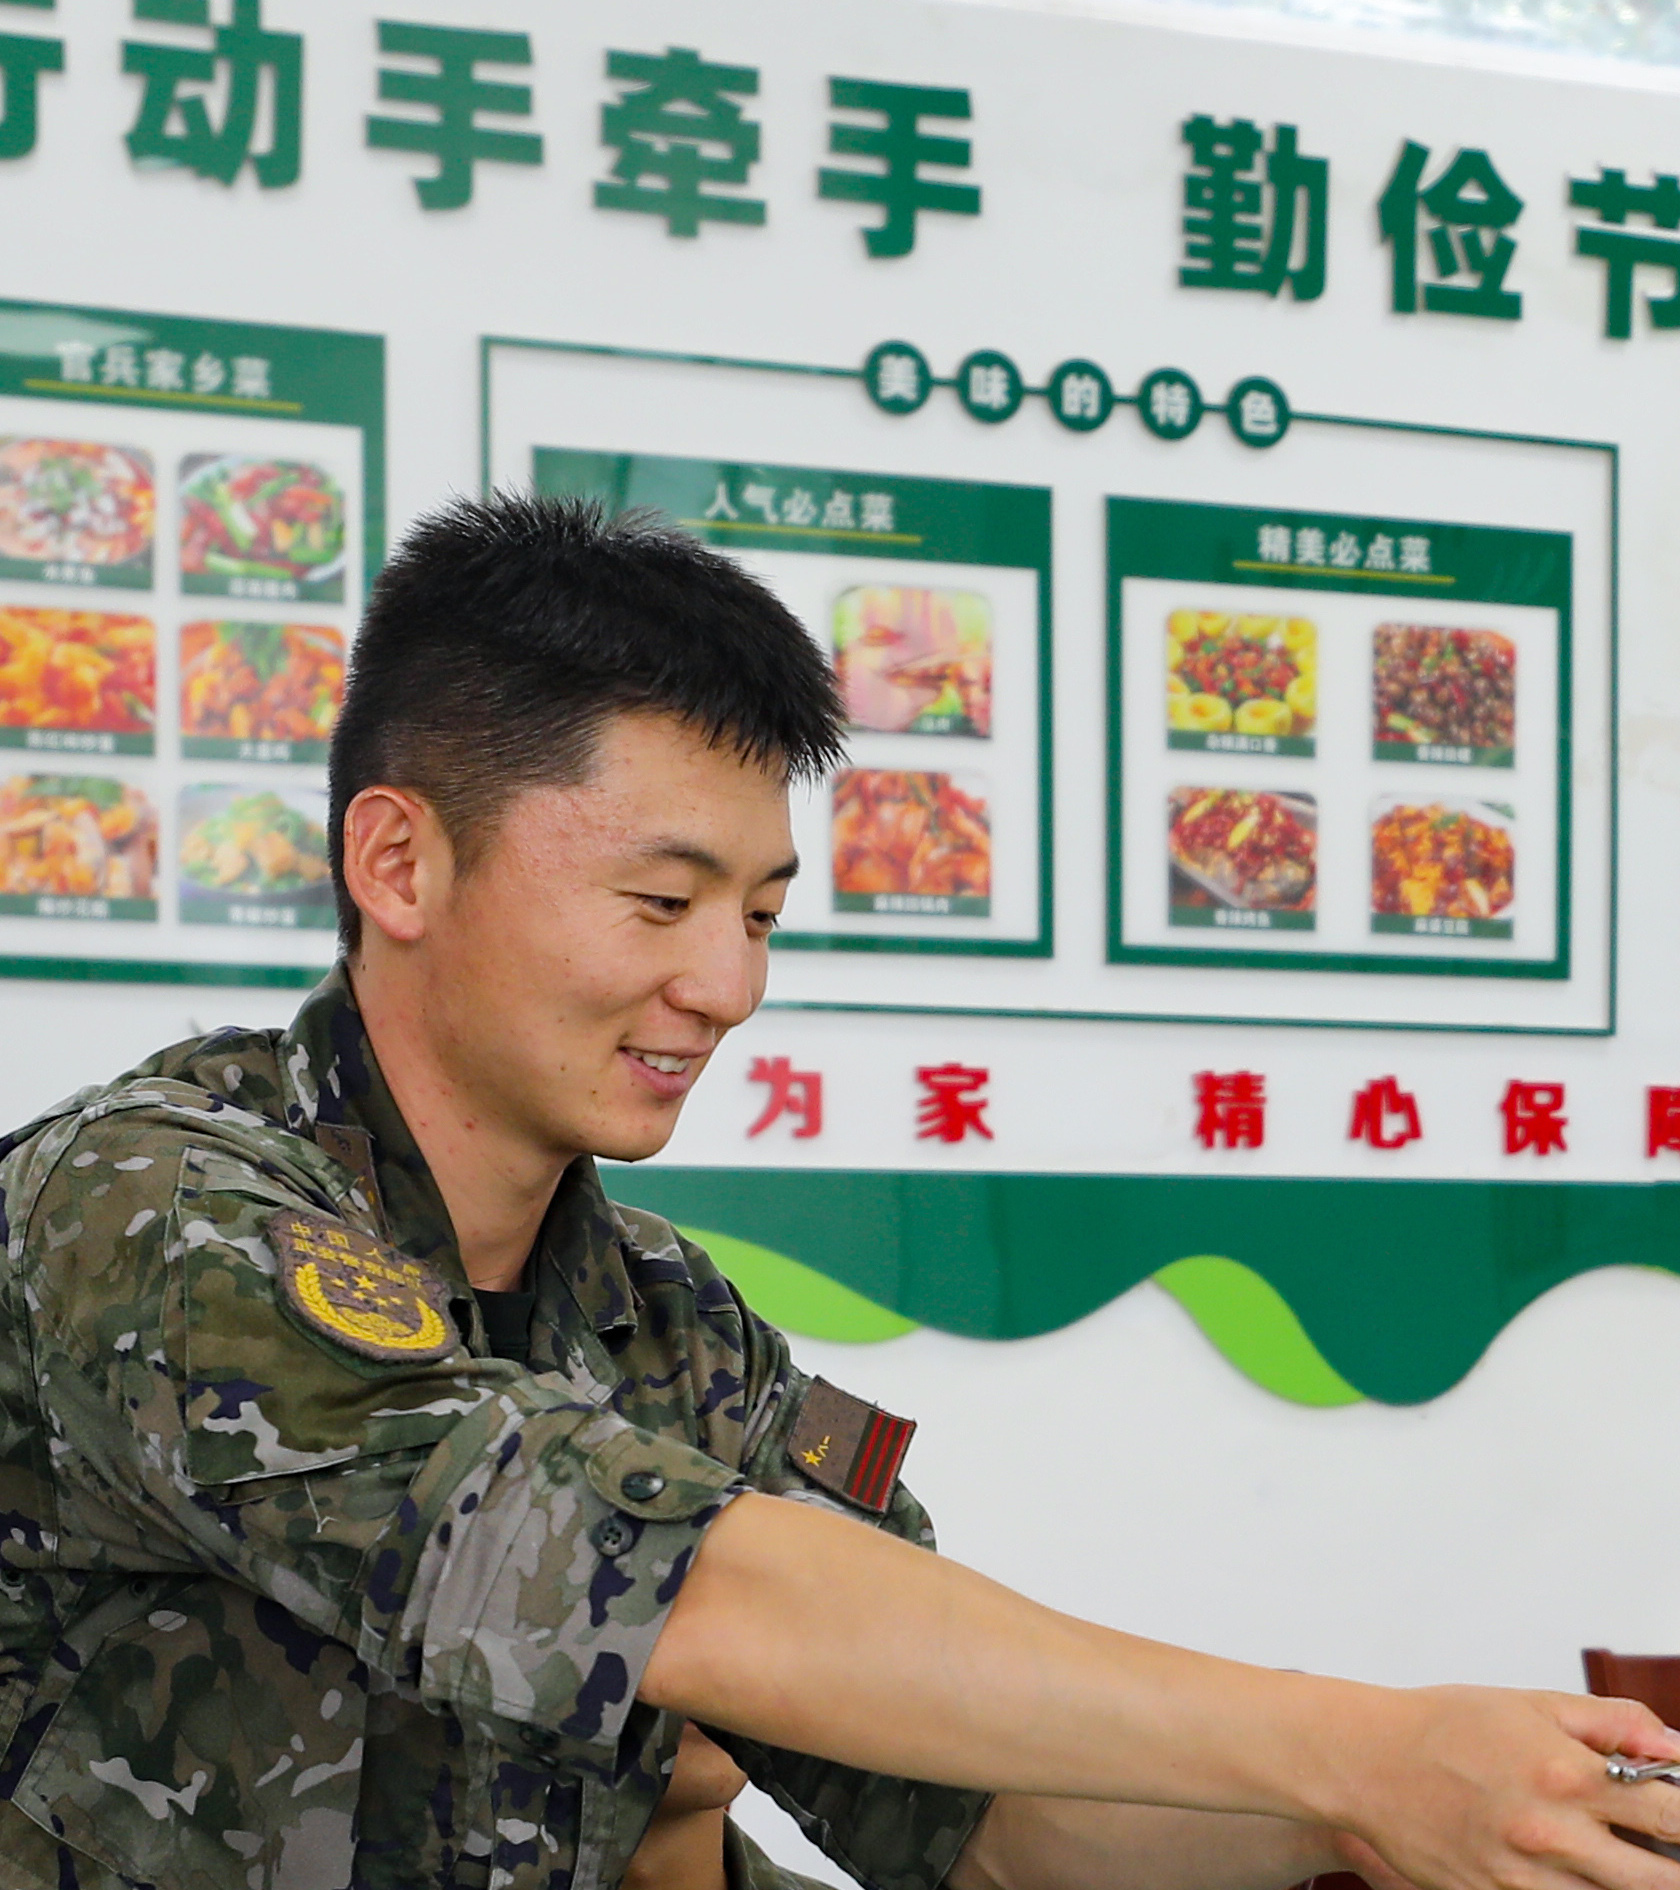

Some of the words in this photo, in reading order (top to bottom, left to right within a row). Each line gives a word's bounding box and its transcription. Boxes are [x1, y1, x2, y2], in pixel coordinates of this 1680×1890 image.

[54, 339, 272, 399] 官兵家乡菜
[877, 351, 1278, 437] 美味的特色
[705, 482, 896, 532] 人气必点菜
[1257, 523, 1432, 572] 精美必点菜
[746, 1054, 995, 1145] 为家
[290, 1220, 422, 1277] 中国人民
